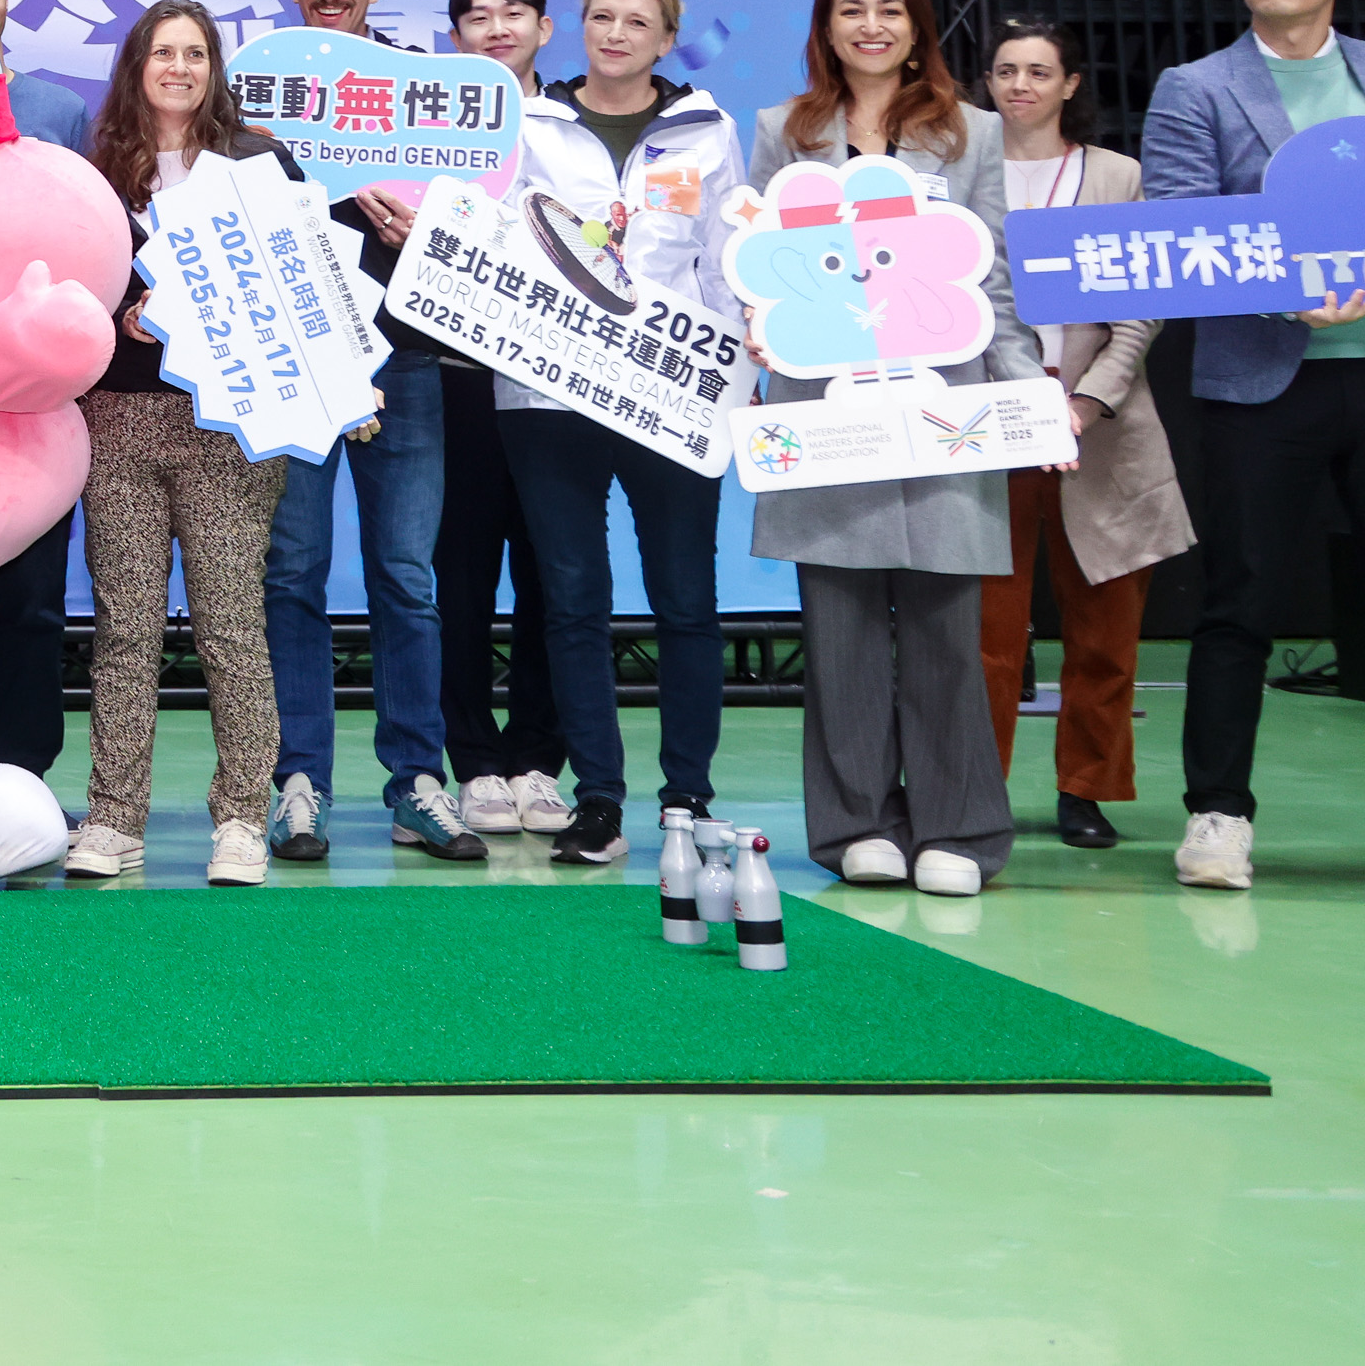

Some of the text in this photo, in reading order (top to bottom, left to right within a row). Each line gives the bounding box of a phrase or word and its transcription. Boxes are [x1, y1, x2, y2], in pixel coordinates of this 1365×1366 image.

[231, 71, 505, 132] 運動無性別
[319, 141, 397, 167] beyond
[404, 146, 500, 170] GENDER
[676, 169, 692, 186] 1
[267, 227, 332, 339] 報名時間
[1023, 222, 1287, 293] 一起打木球
[167, 227, 256, 417] 2025年2月17日
[211, 211, 300, 402] 2024年2月17日
[306, 236, 363, 360] WORLD MASTERS GAMES
[423, 227, 730, 405] 雙北世界壯年運動會
[416, 261, 714, 429] WORLD MASTERS GAMES
[644, 300, 741, 367] 2025
[405, 290, 711, 460] 2025.5.17-30 和世界挑一場
[805, 423, 884, 438] INTERNATIONAL
[808, 434, 892, 450] MASTERS GAMES
[811, 447, 880, 462] ASSOCIATION
[1004, 429, 1034, 441] 2025
